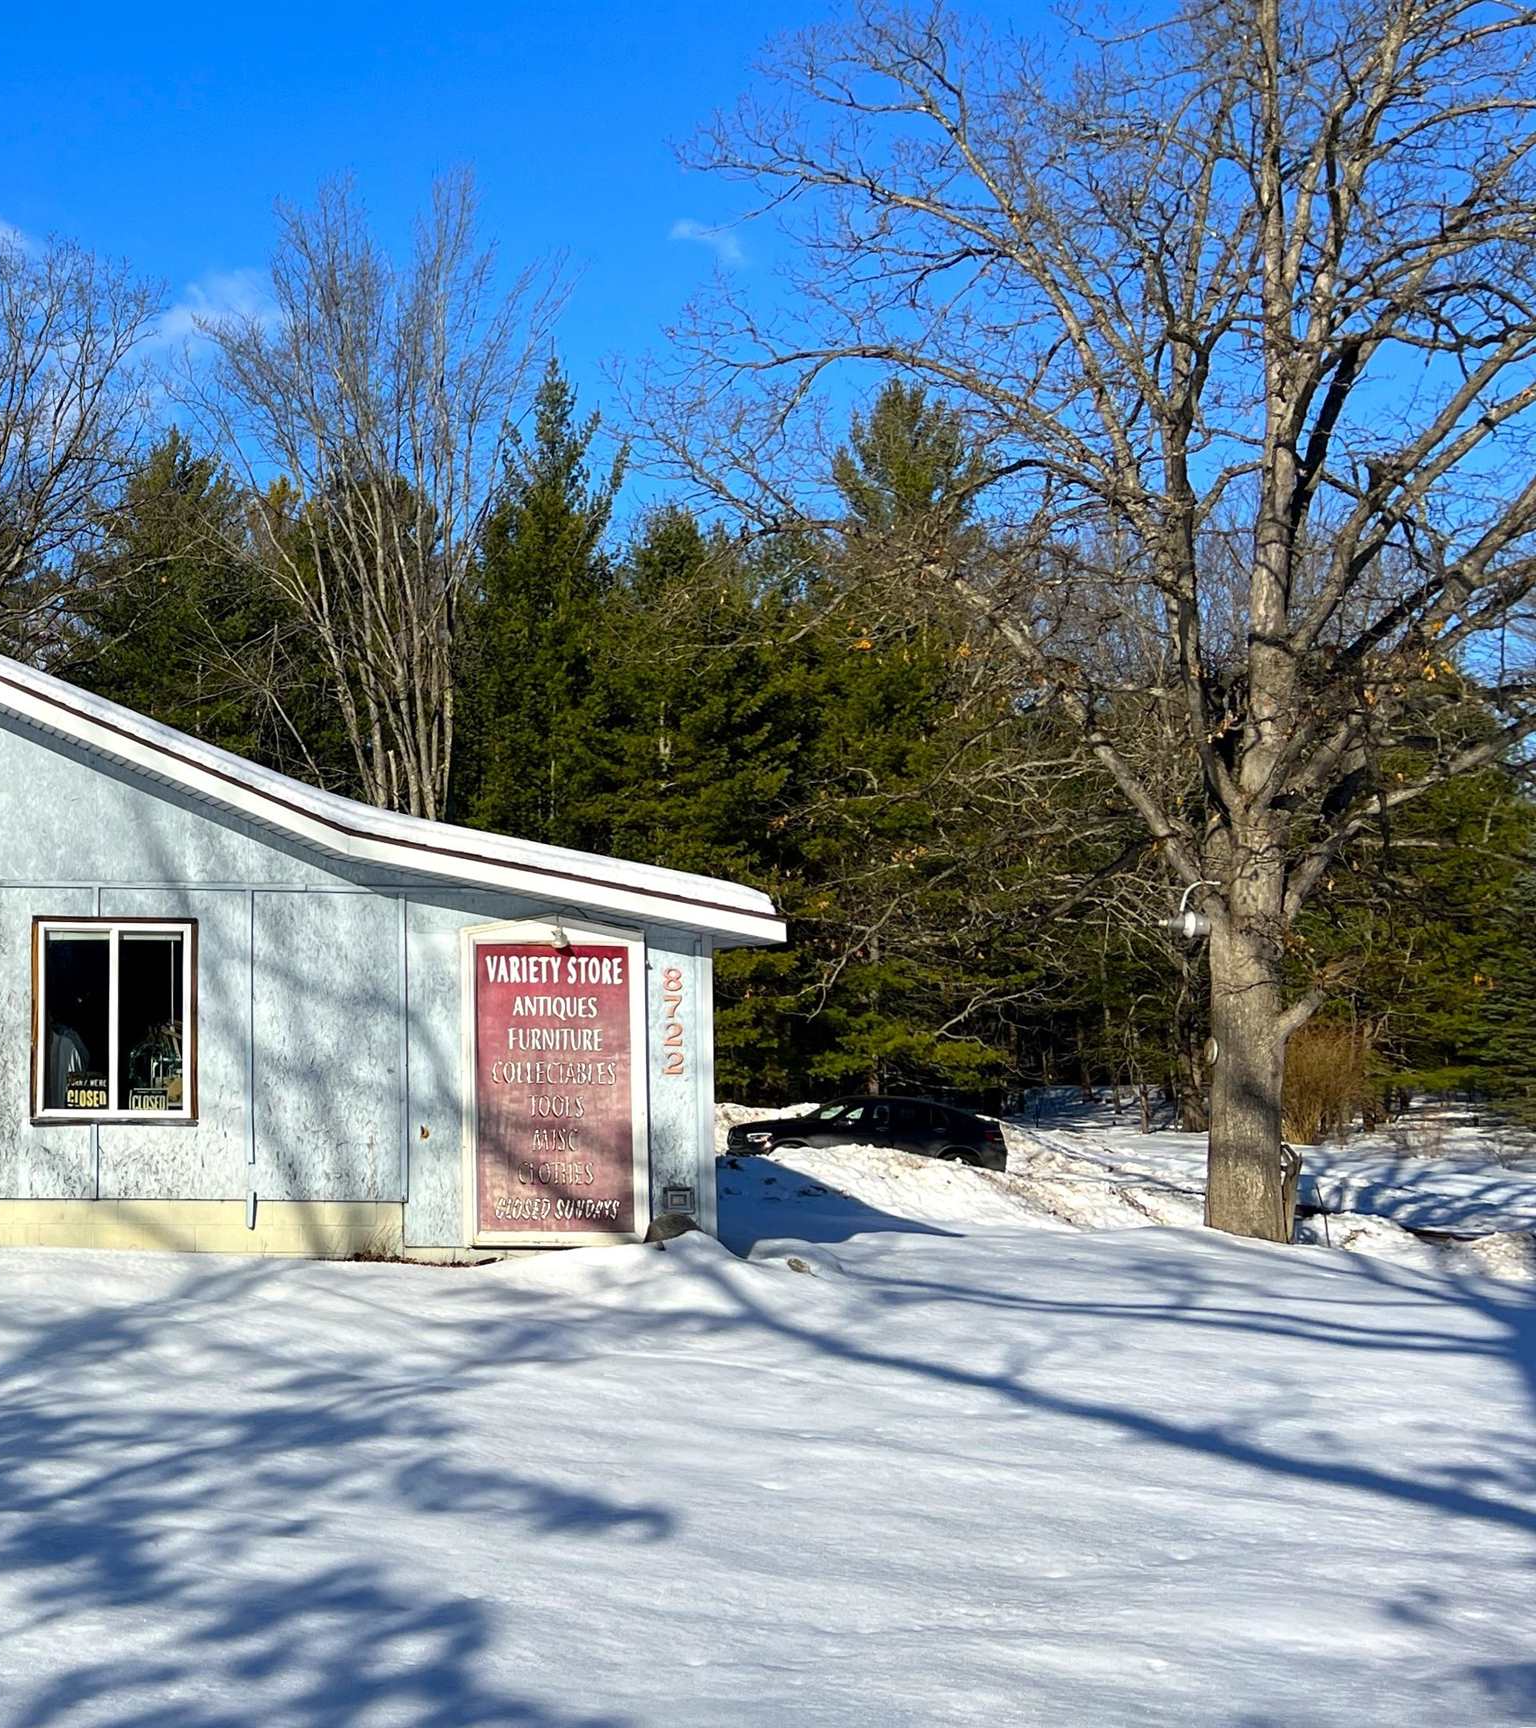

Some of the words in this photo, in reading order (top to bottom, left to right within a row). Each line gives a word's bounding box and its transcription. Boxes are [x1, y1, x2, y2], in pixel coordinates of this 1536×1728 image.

[485, 955, 561, 984] VARIETY
[567, 956, 623, 985] STORE
[512, 996, 598, 1021] ANTIQUES
[662, 968, 684, 1075] 8722
[507, 1028, 603, 1051] FURNITURE
[492, 1061, 617, 1084] COLLECTABLES
[67, 1089, 107, 1108] CLOSED
[132, 1095, 166, 1110] CLOSED
[528, 1095, 585, 1117] TOOLS
[532, 1128, 578, 1151] MISC
[517, 1161, 594, 1185] CLOTHES
[495, 1197, 551, 1220] CLOSED
[555, 1197, 621, 1220] SUNDAYS
